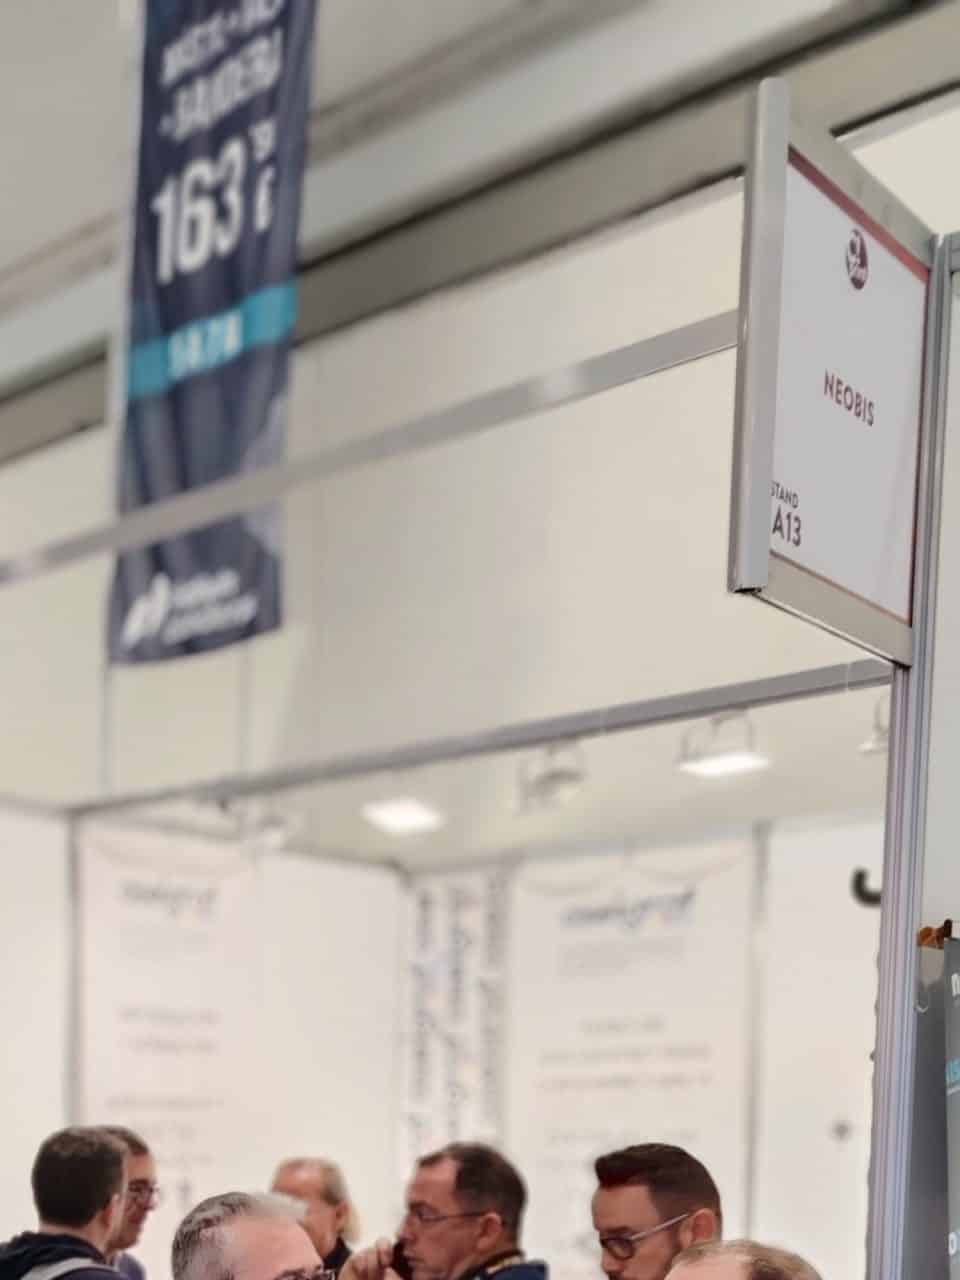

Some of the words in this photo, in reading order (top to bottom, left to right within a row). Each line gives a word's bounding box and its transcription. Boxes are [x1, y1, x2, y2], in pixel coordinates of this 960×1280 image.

[151, 136, 247, 285] 163
[823, 368, 875, 427] NEOBIS
[771, 480, 799, 509] STAND
[772, 505, 802, 547] A13
